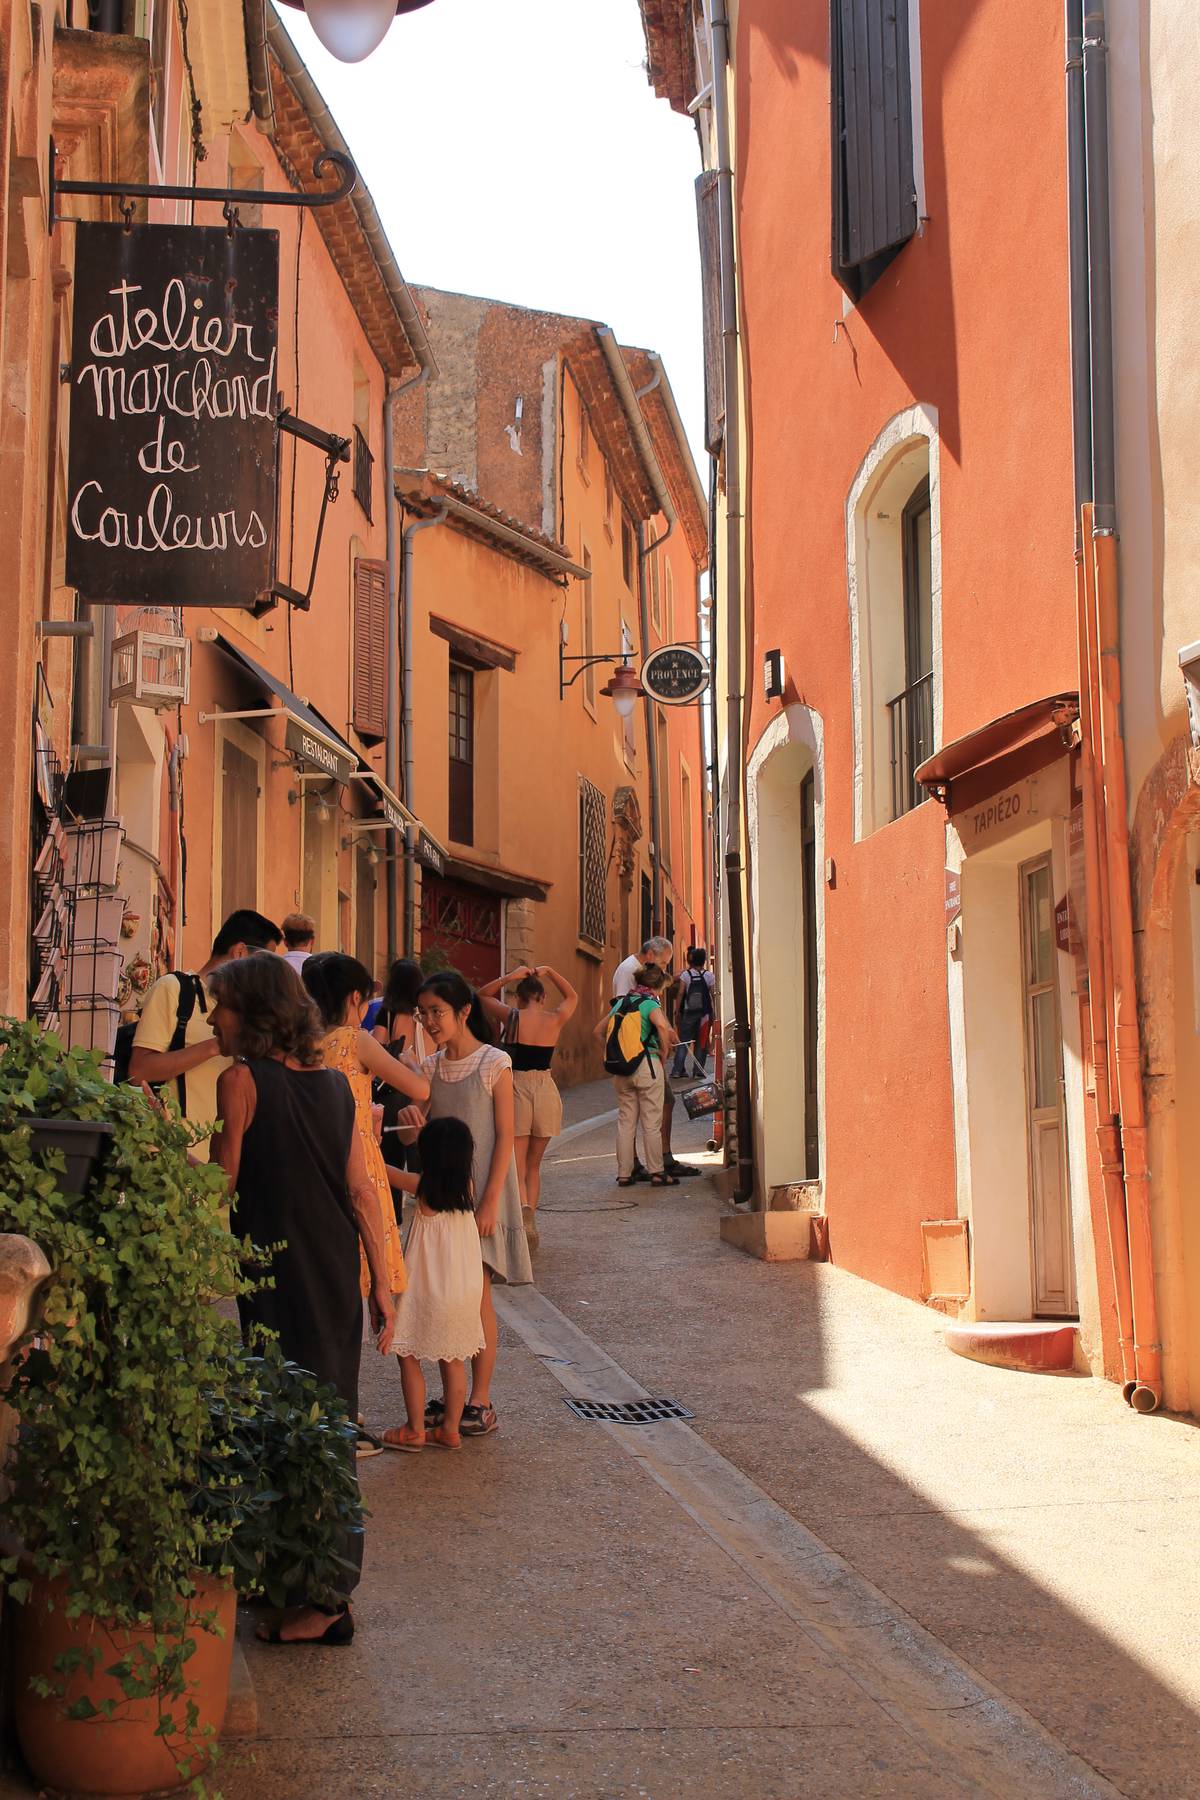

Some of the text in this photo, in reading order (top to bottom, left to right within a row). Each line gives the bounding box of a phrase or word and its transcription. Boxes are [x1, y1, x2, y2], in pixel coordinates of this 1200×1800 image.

[90, 279, 264, 361] atelier
[77, 346, 277, 421] marchand
[138, 415, 200, 474] de
[71, 480, 268, 552] Couleurs
[650, 669, 700, 680] PROVENCE
[302, 735, 339, 773] RESTAURANT
[974, 794, 1021, 834] TAPIÉZO
